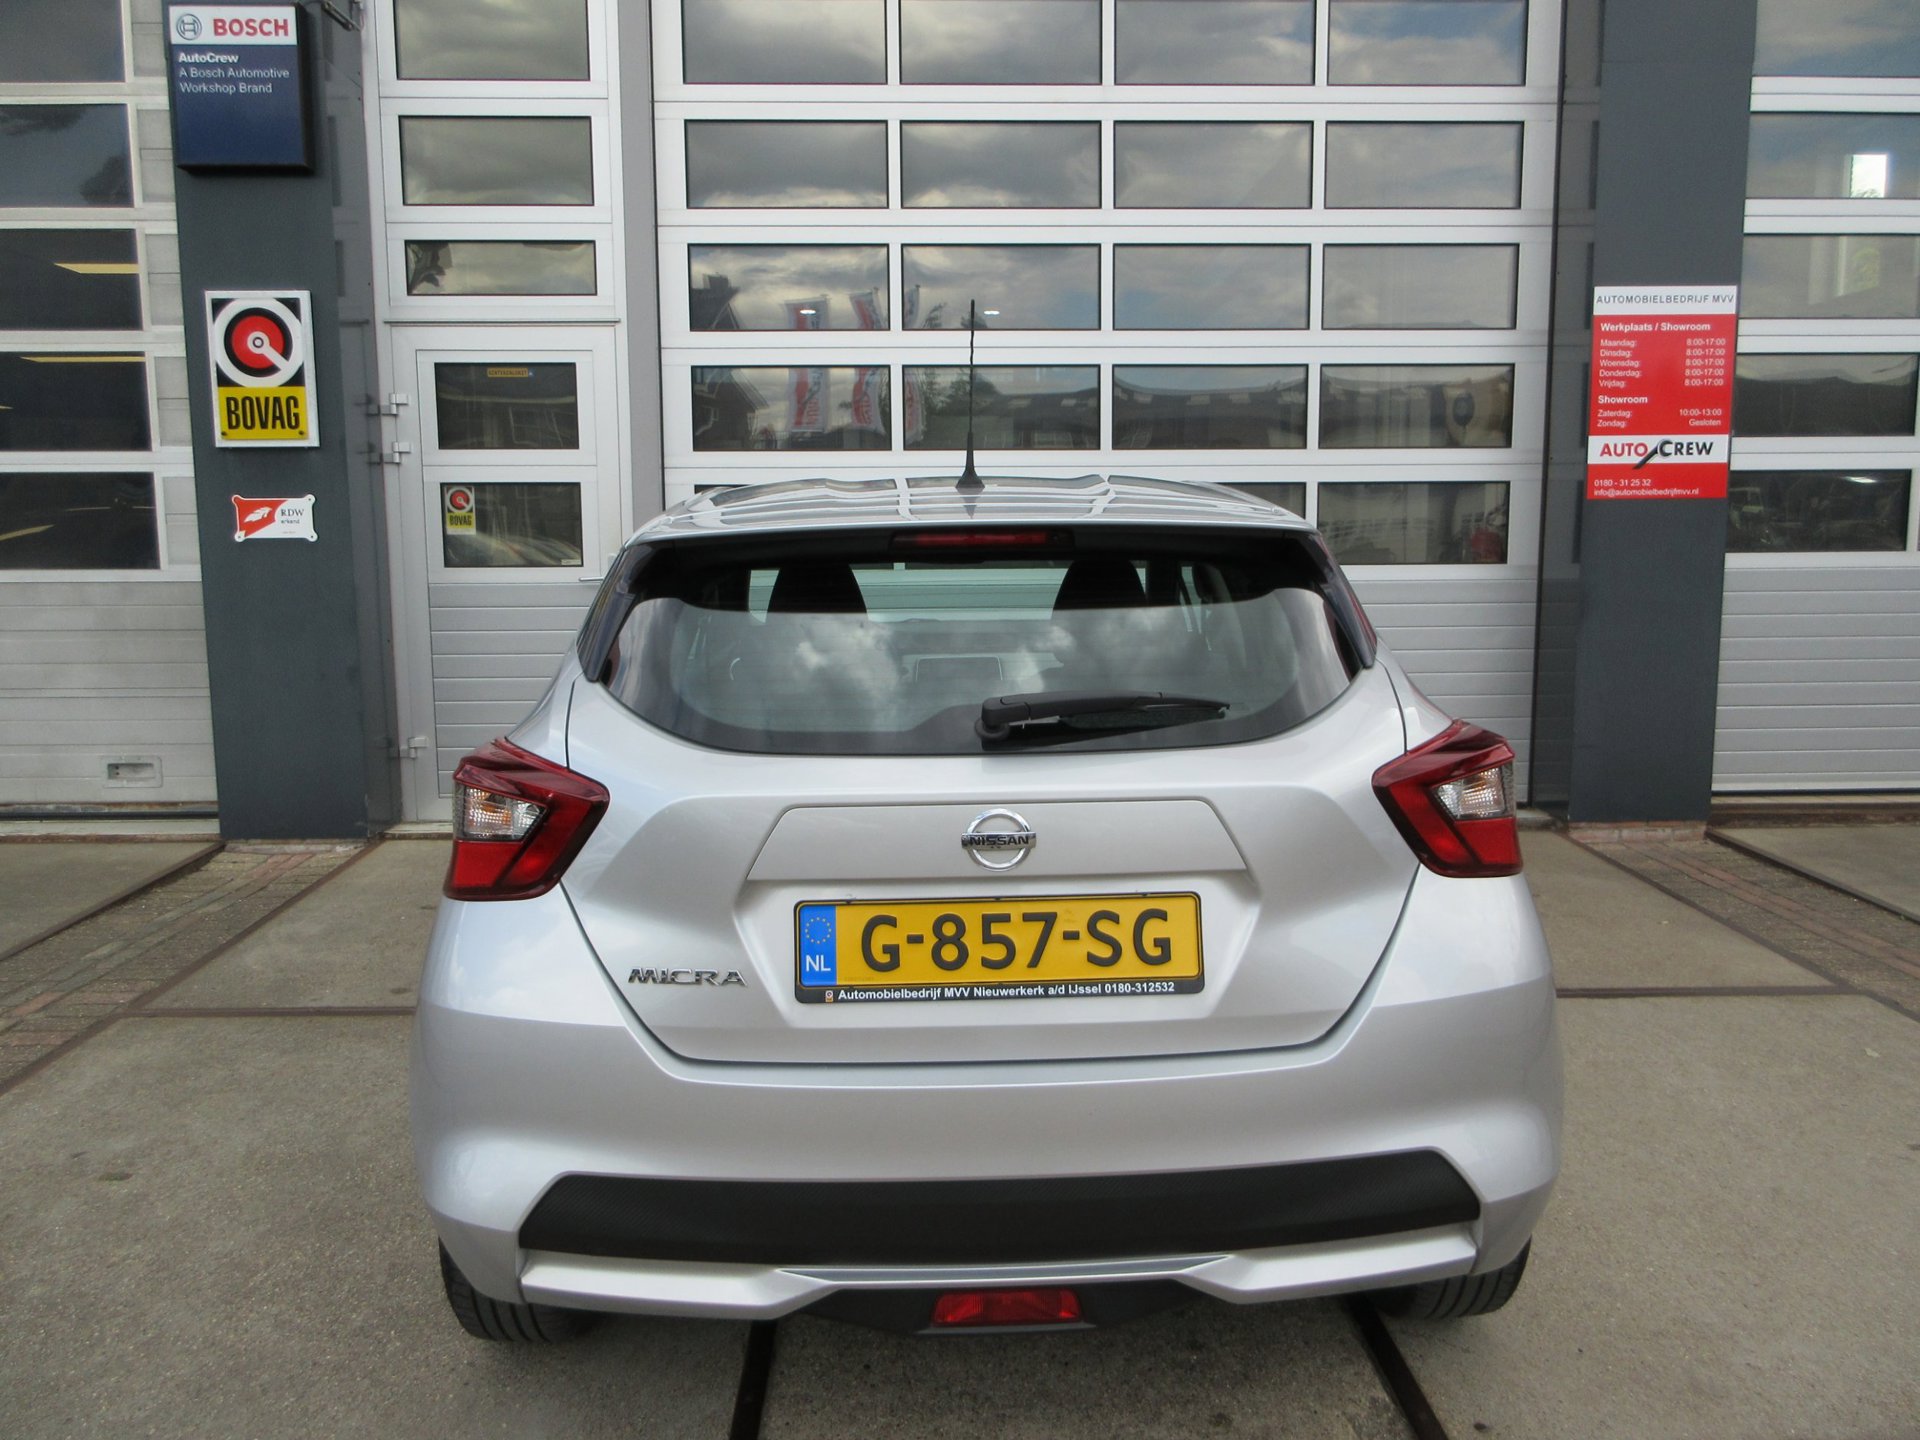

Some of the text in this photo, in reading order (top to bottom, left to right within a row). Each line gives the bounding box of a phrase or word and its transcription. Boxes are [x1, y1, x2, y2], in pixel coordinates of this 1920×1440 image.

[213, 18, 289, 37] BOSCH
[178, 52, 239, 63] AutoCrew
[179, 68, 290, 78] A Bosch Automotive
[179, 82, 273, 95] Workshop Brand
[1596, 294, 1734, 304] AUTOMOBIELBEDRIJF MVV
[1600, 322, 1653, 332] Werkplaats
[1660, 322, 1711, 331] Showroom
[1600, 338, 1726, 348] Maandag: 8:00-17:00
[1599, 348, 1726, 358] Dinsdag: 8:00-17:00
[1599, 358, 1725, 368] Woensdag: 8:00-17:00
[1599, 368, 1724, 378] Donderdag: 8:00-17:00
[1598, 378, 1724, 388] Vrijdag: 8:00-17:00
[1598, 395, 1648, 404] Showroom
[225, 395, 300, 431] BOVAG
[1597, 408, 1722, 418] Zaterdag: 10:00-13:00
[1597, 418, 1721, 428] Zondag: Gesloten
[1599, 438, 1714, 457] AUTO CREW
[1594, 479, 1613, 487] 0180
[1619, 479, 1628, 487] 31
[1630, 479, 1641, 487] 25
[1642, 479, 1652, 487] 32
[1594, 487, 1699, 497] info@automobielbedrijfmvv.nl
[280, 508, 305, 517] RDW
[449, 514, 473, 527] BOVAG
[969, 835, 1029, 846] NISSAN
[861, 908, 1172, 973] G-857-SG
[805, 954, 832, 972] NL
[627, 967, 748, 987] MICRA
[838, 981, 1175, 1000] Automobielbedrijf MVV Nieuwerkerk a/d IJssel 0180-312532
